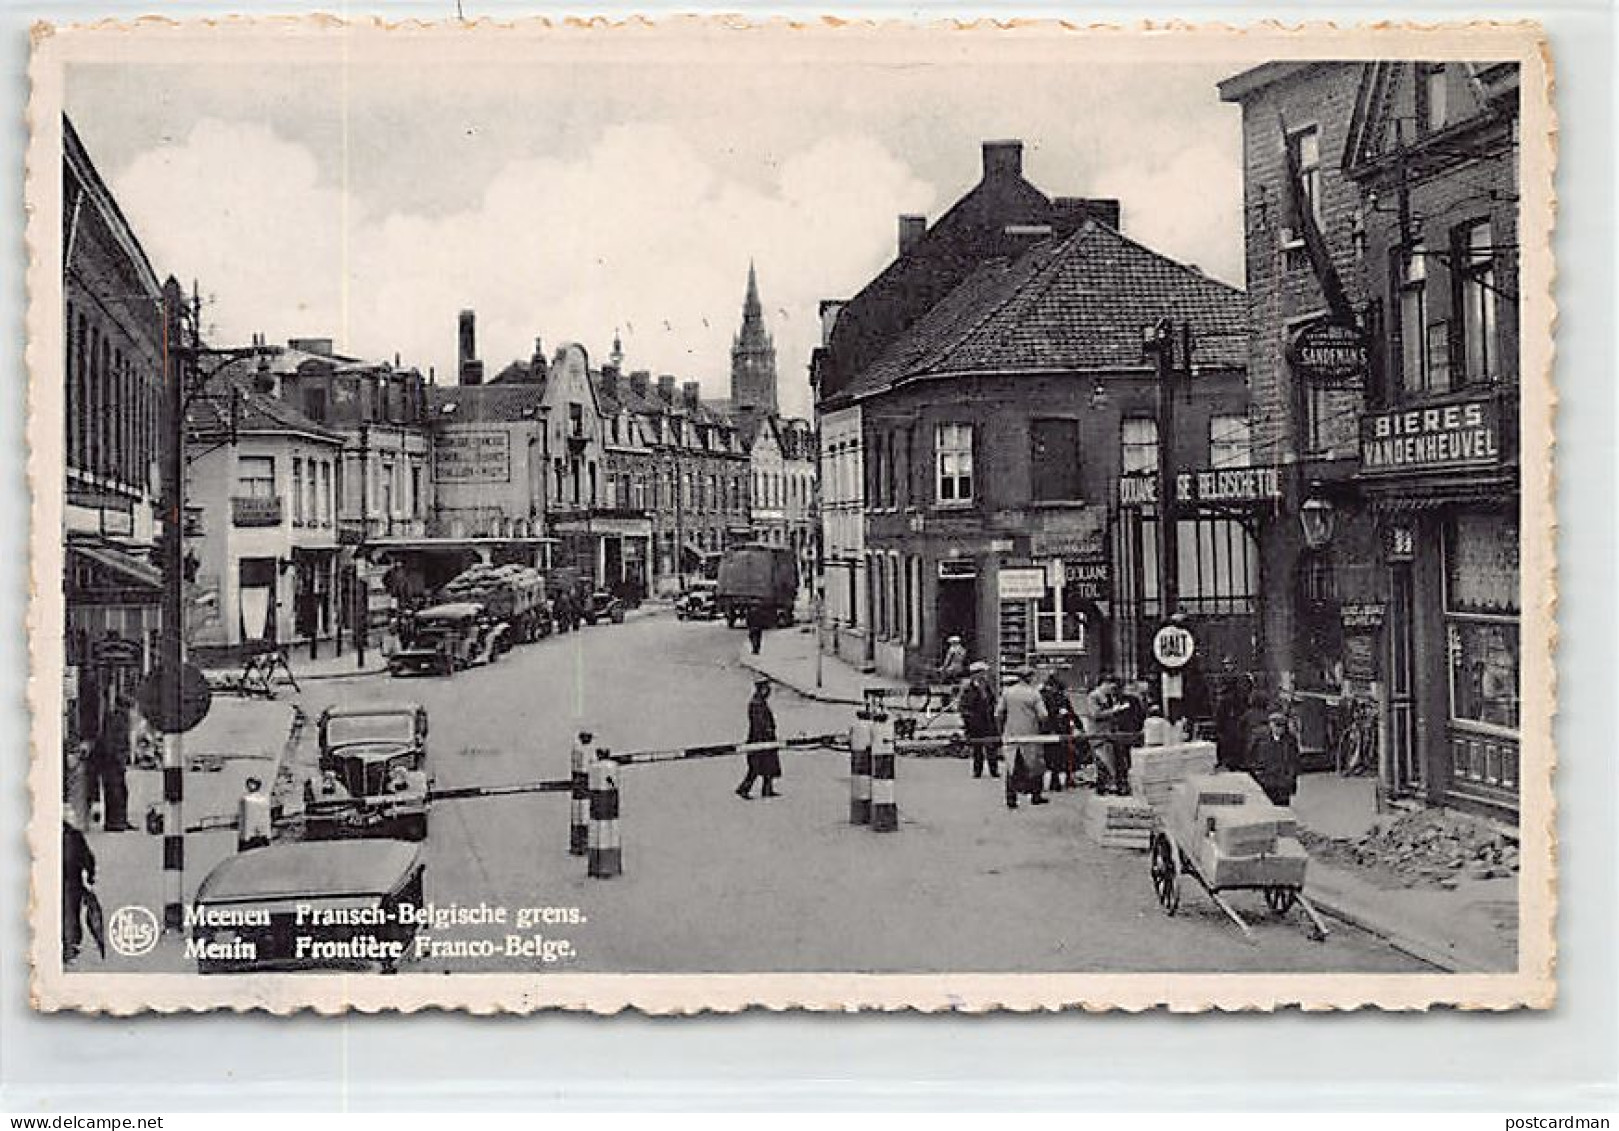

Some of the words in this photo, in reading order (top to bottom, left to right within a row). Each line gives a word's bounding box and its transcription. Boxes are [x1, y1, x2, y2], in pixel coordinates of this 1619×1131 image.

[1375, 403, 1482, 437] BIERES
[1363, 428, 1499, 466] VANDENHEUVEL
[1119, 476, 1158, 504] DOUANE
[1160, 634, 1188, 658] HALT
